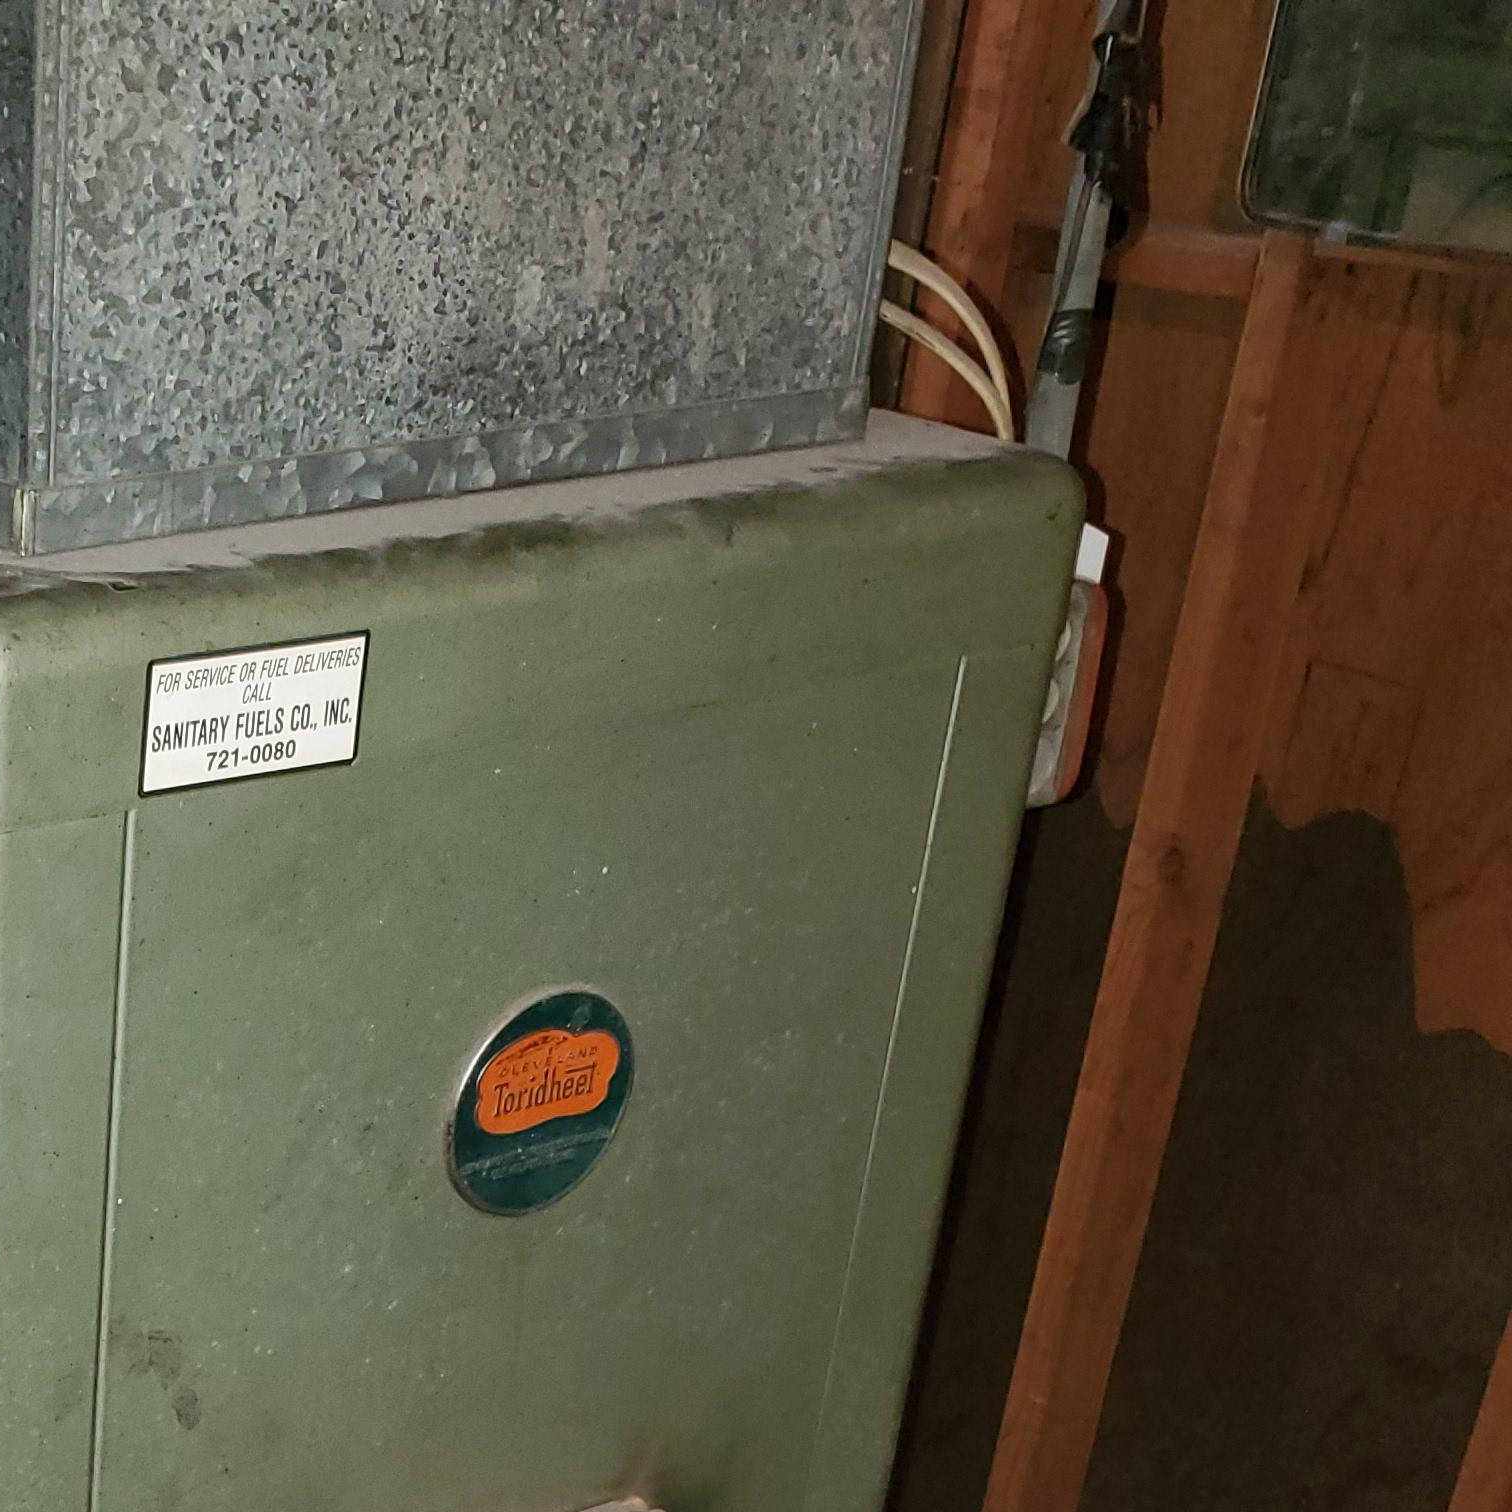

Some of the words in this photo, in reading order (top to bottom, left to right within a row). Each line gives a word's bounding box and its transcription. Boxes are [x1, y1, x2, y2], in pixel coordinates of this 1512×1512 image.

[156, 673, 181, 694] FOR
[185, 664, 237, 690] SERVICE
[239, 662, 257, 683] OR
[260, 657, 289, 680] FUEL
[294, 646, 361, 674] DELIVERIES
[242, 682, 272, 705] CALL
[152, 715, 229, 752] SANITARY
[235, 707, 284, 740] FUELS
[290, 703, 317, 731] CO.,
[323, 697, 352, 727] INC.
[206, 739, 296, 772] 721-0080
